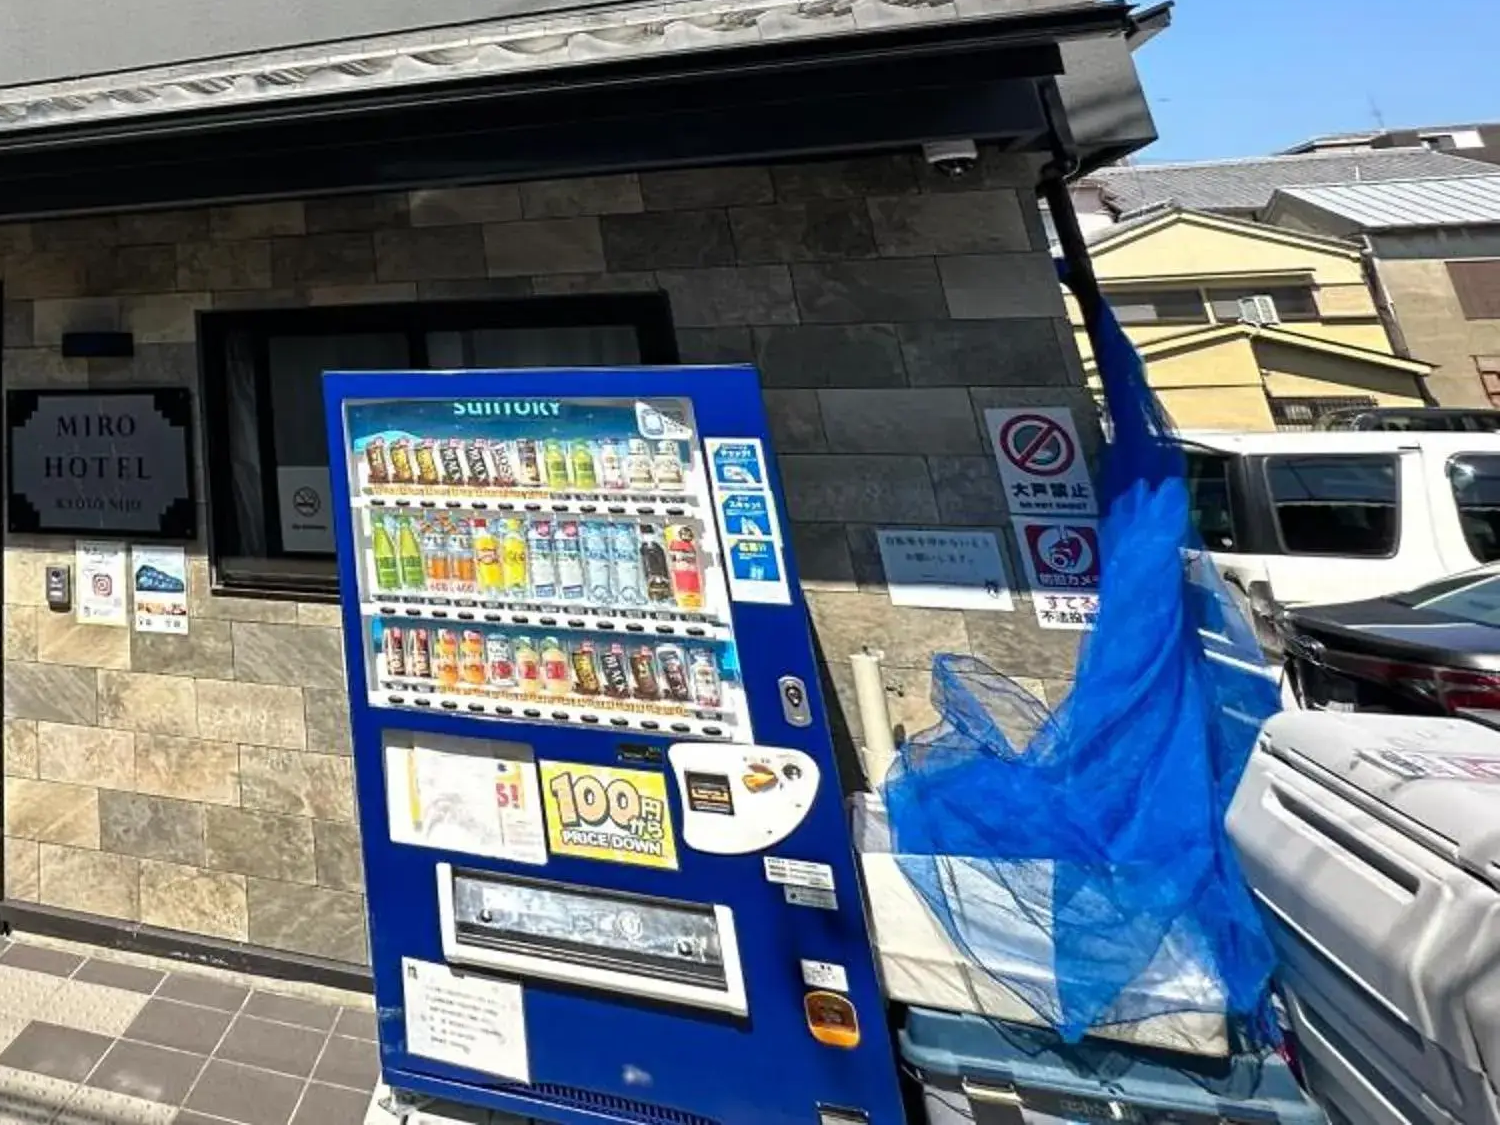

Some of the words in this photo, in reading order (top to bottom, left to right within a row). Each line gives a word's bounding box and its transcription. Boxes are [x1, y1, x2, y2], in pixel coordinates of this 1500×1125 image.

[57, 414, 137, 437] MIRO
[44, 456, 153, 480] HOTEL
[610, 836, 663, 857] DOWN
